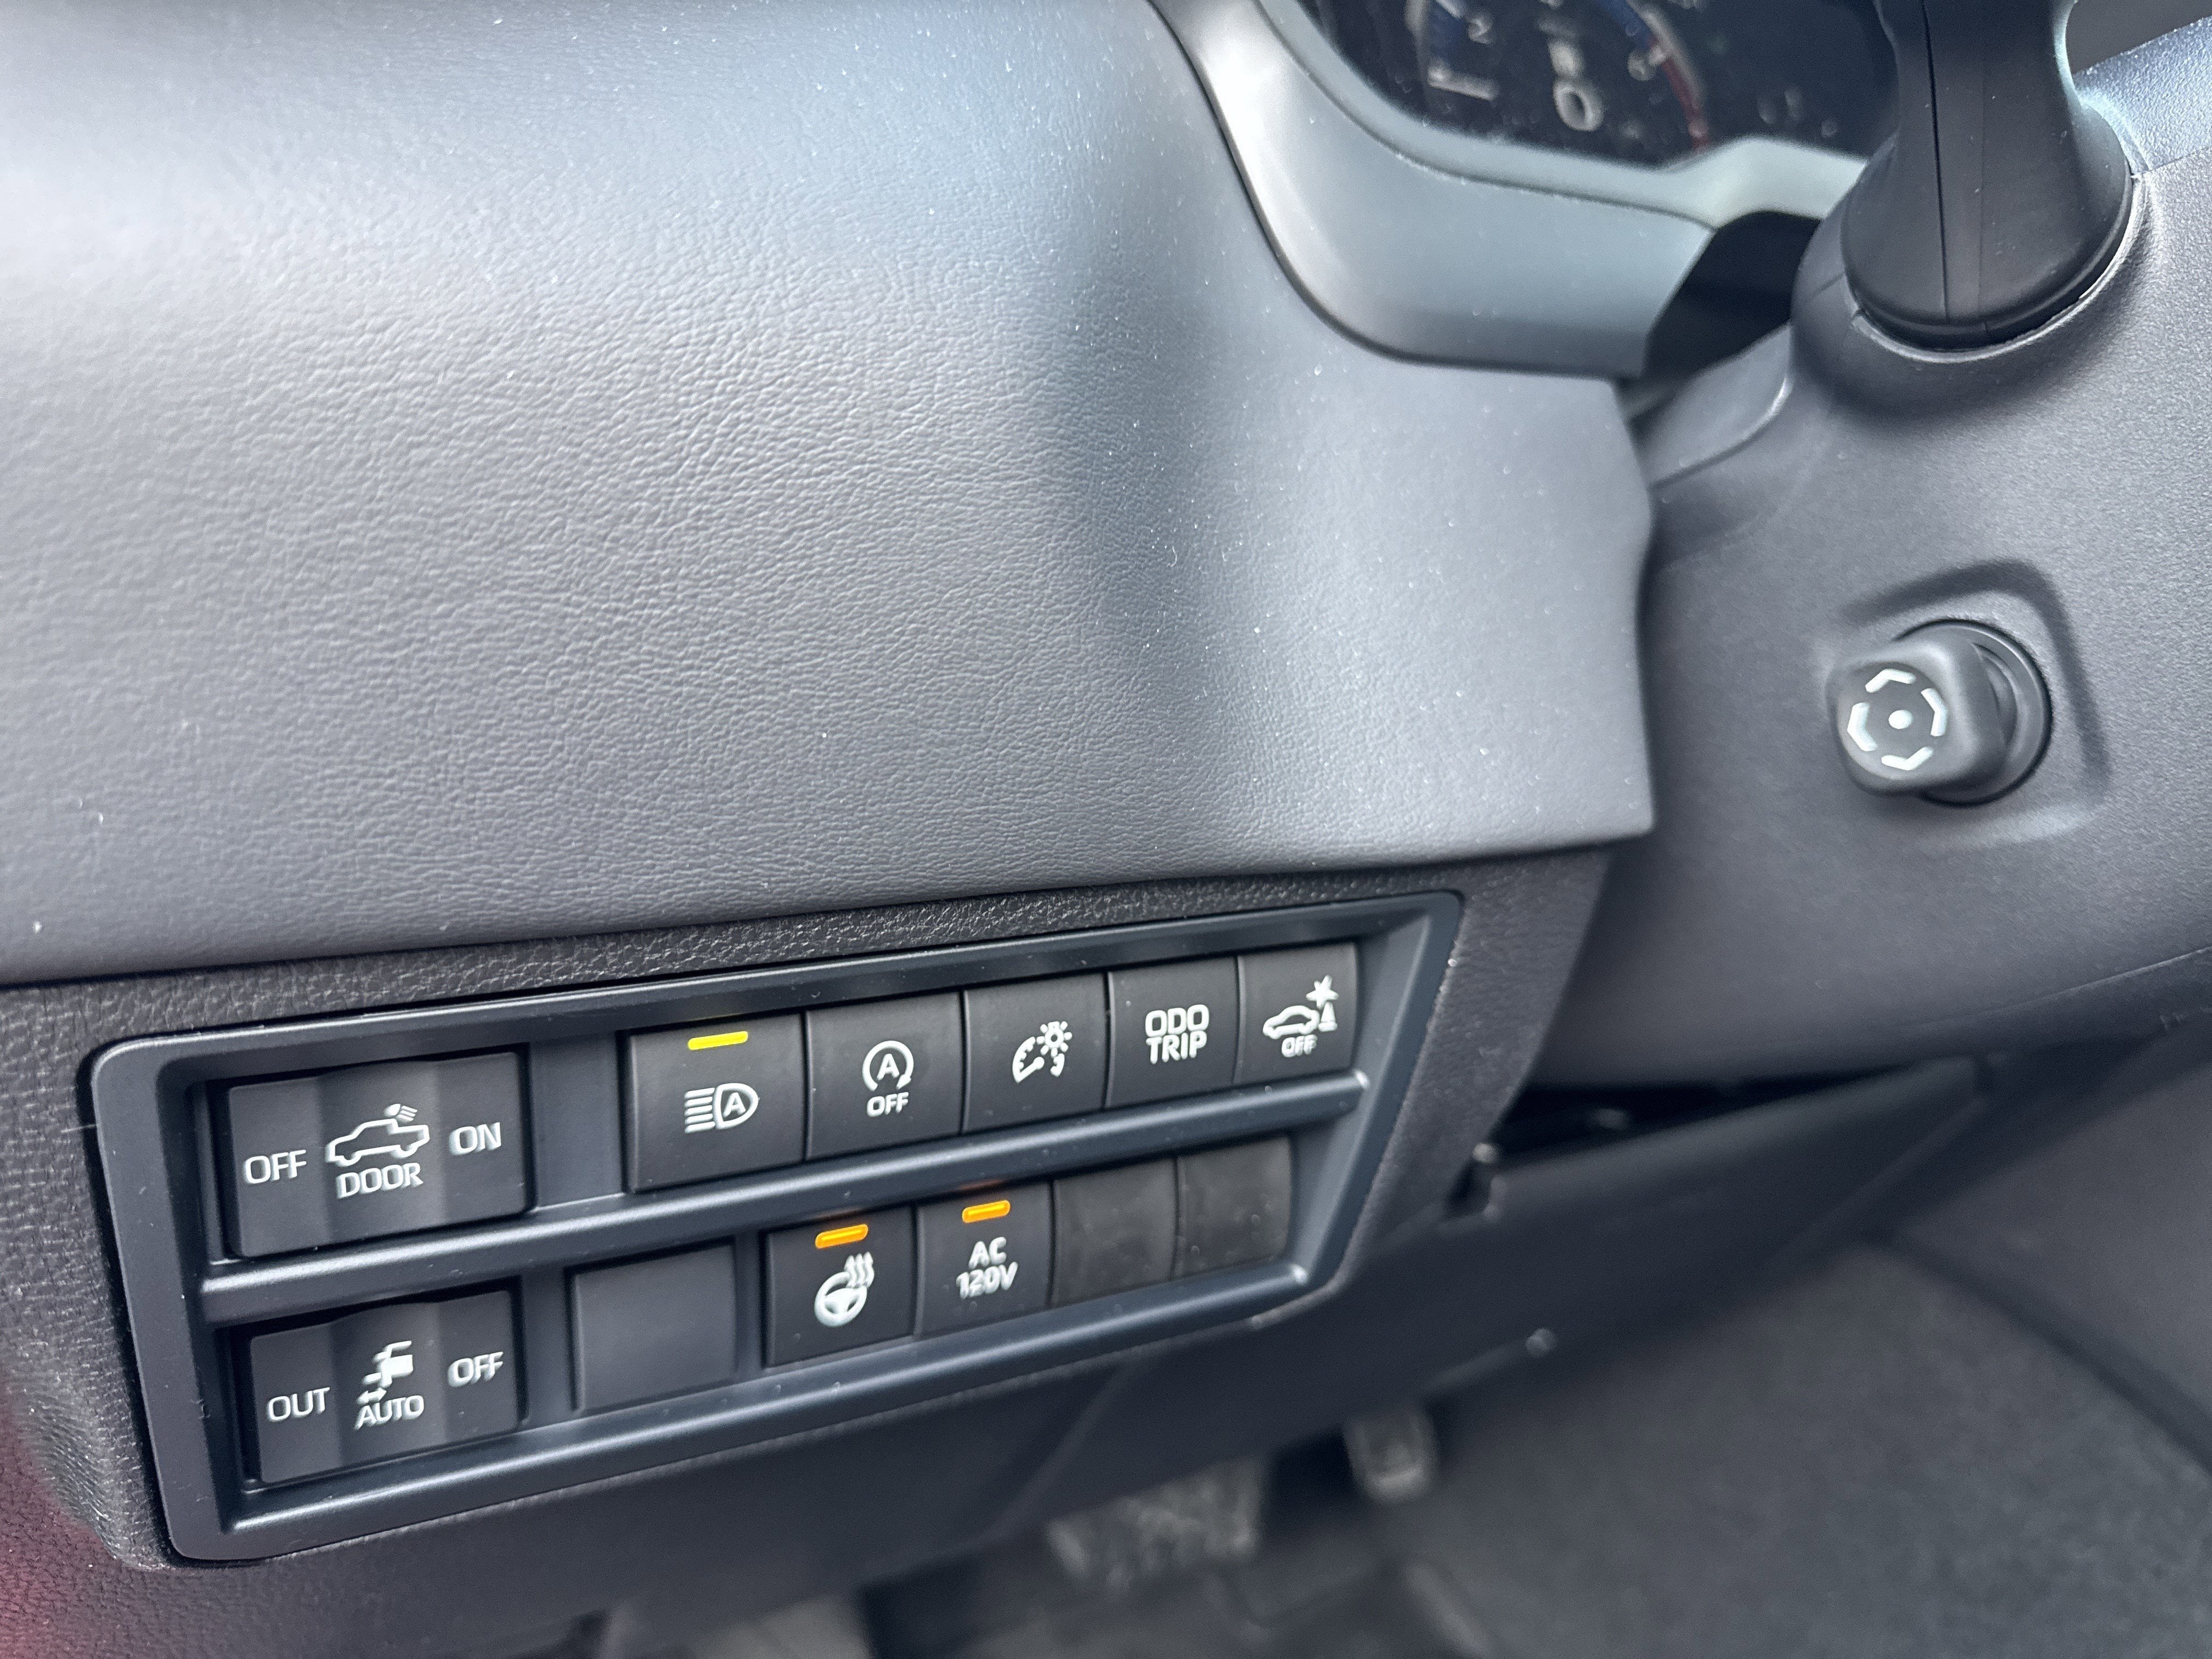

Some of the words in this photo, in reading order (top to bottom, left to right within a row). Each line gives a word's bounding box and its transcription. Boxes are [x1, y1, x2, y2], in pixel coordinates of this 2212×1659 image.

[1145, 1005, 1209, 1037] ODO
[1146, 1030, 1208, 1064] TRIP
[1282, 1034, 1318, 1058] OFF
[867, 1092, 909, 1117] OFF
[449, 1122, 501, 1155] ON
[244, 1150, 307, 1184] OFF
[336, 1162, 424, 1199] DOOR
[968, 1237, 1007, 1268] AC
[956, 1262, 1018, 1299] 120V
[448, 1351, 504, 1387] OFF
[267, 1387, 330, 1421] OUT
[354, 1395, 425, 1430] AUTO
